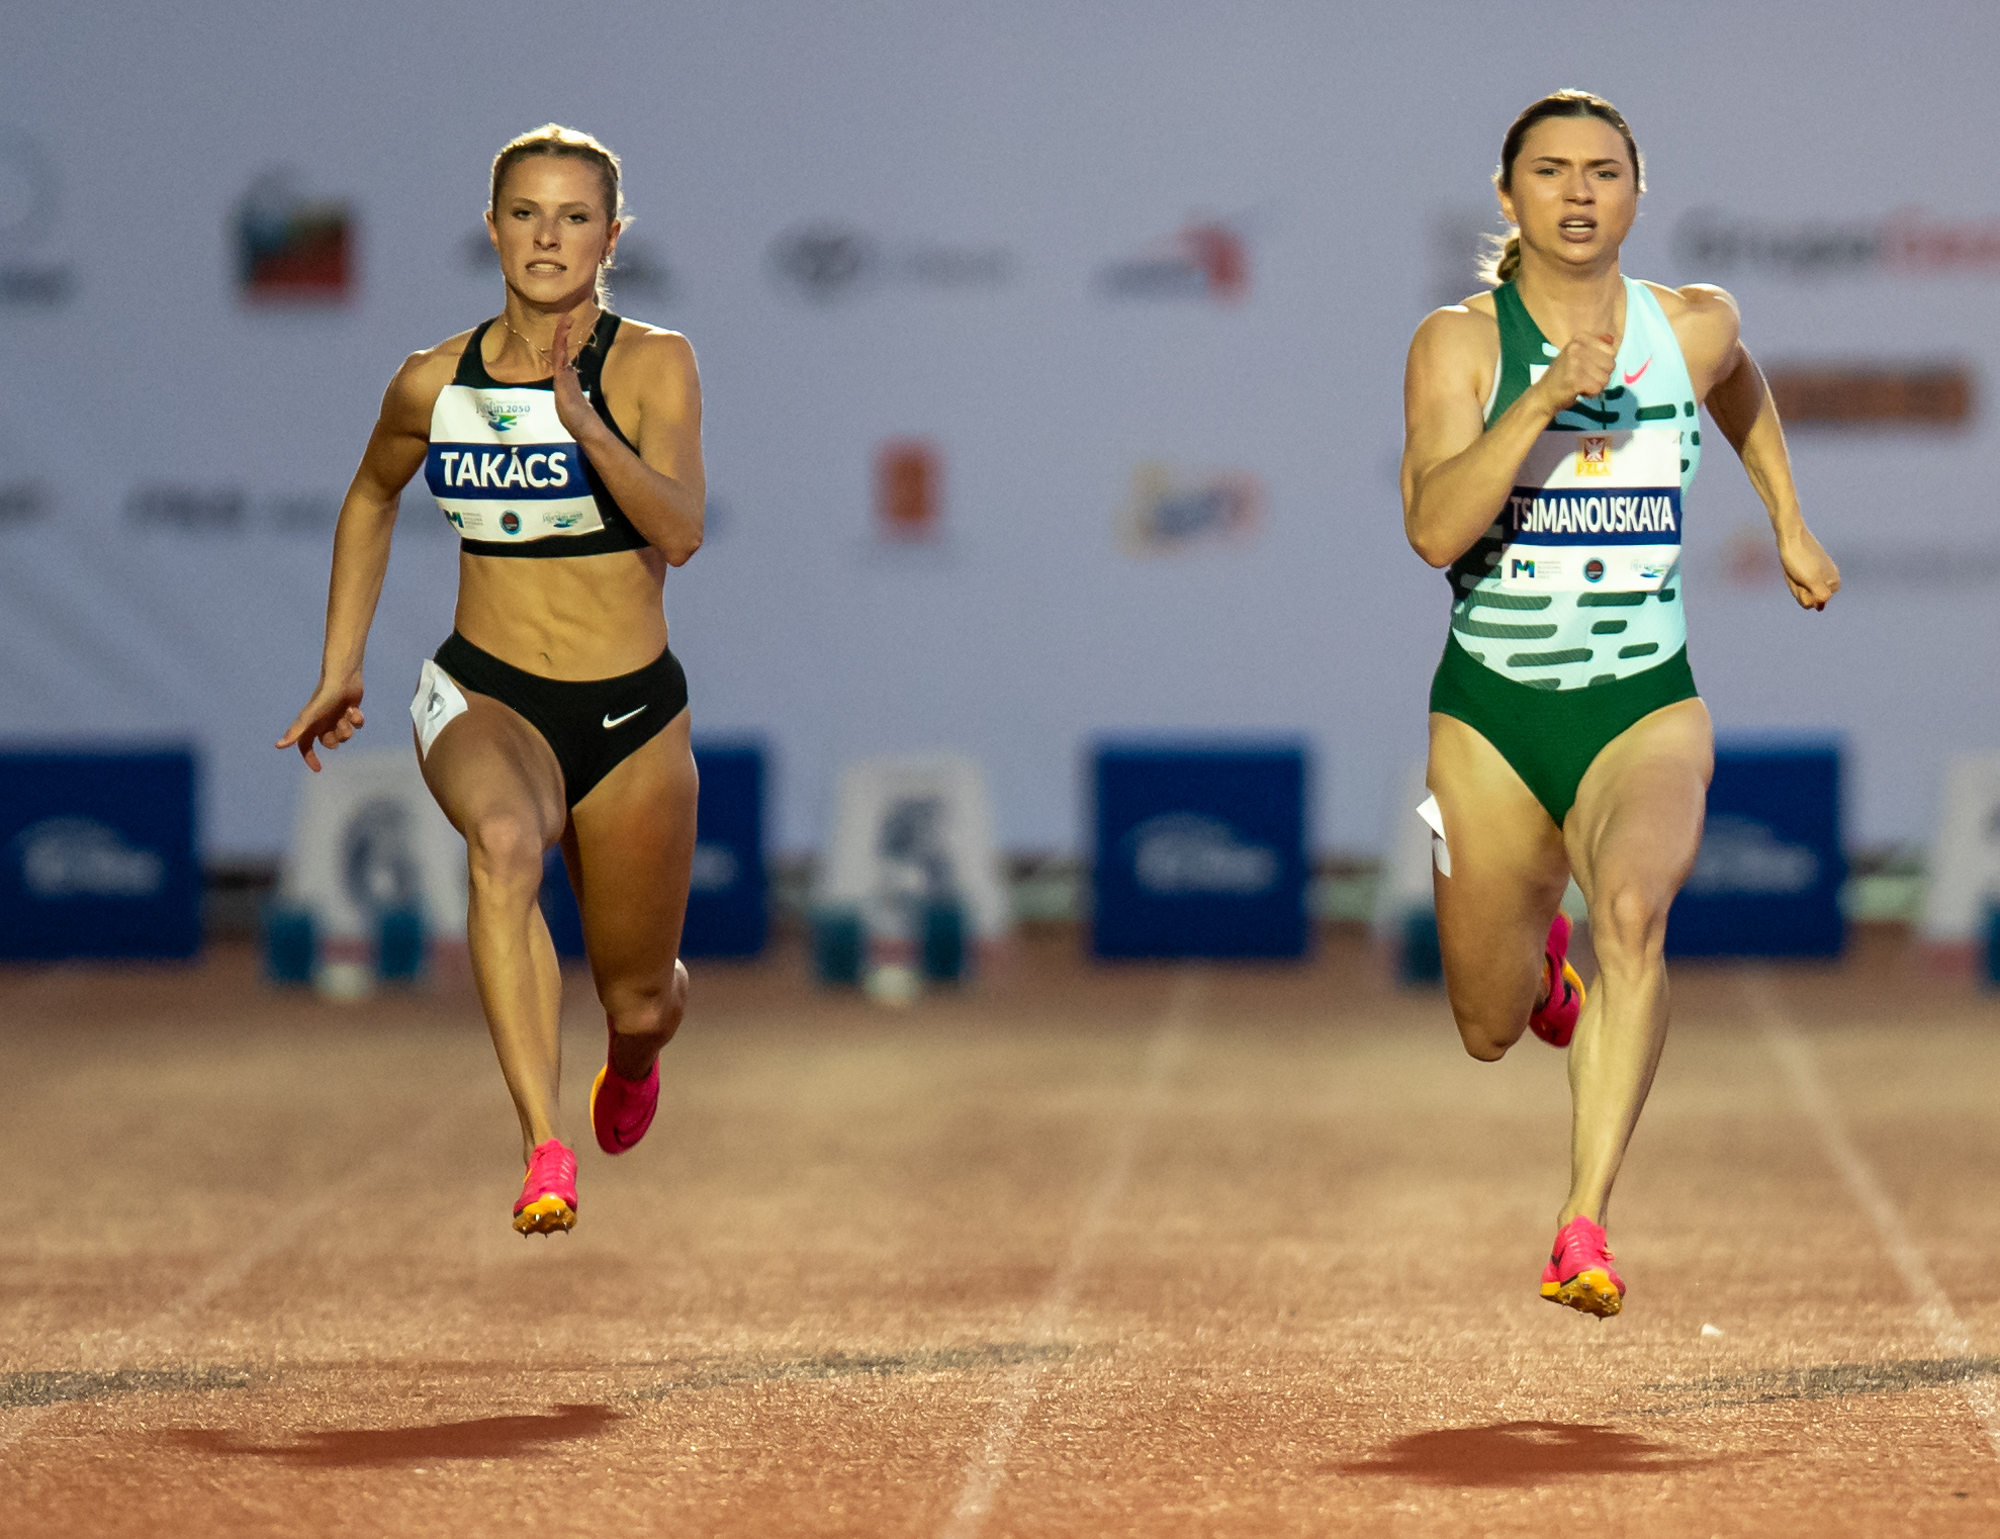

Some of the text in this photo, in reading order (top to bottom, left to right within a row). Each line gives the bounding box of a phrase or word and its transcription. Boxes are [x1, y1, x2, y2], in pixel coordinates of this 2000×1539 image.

[440, 447, 569, 489] TAKÁCS
[1577, 463, 1609, 474] PZLA
[1511, 496, 1676, 533] TSIMANOUSKAYA
[1510, 558, 1535, 579] M
